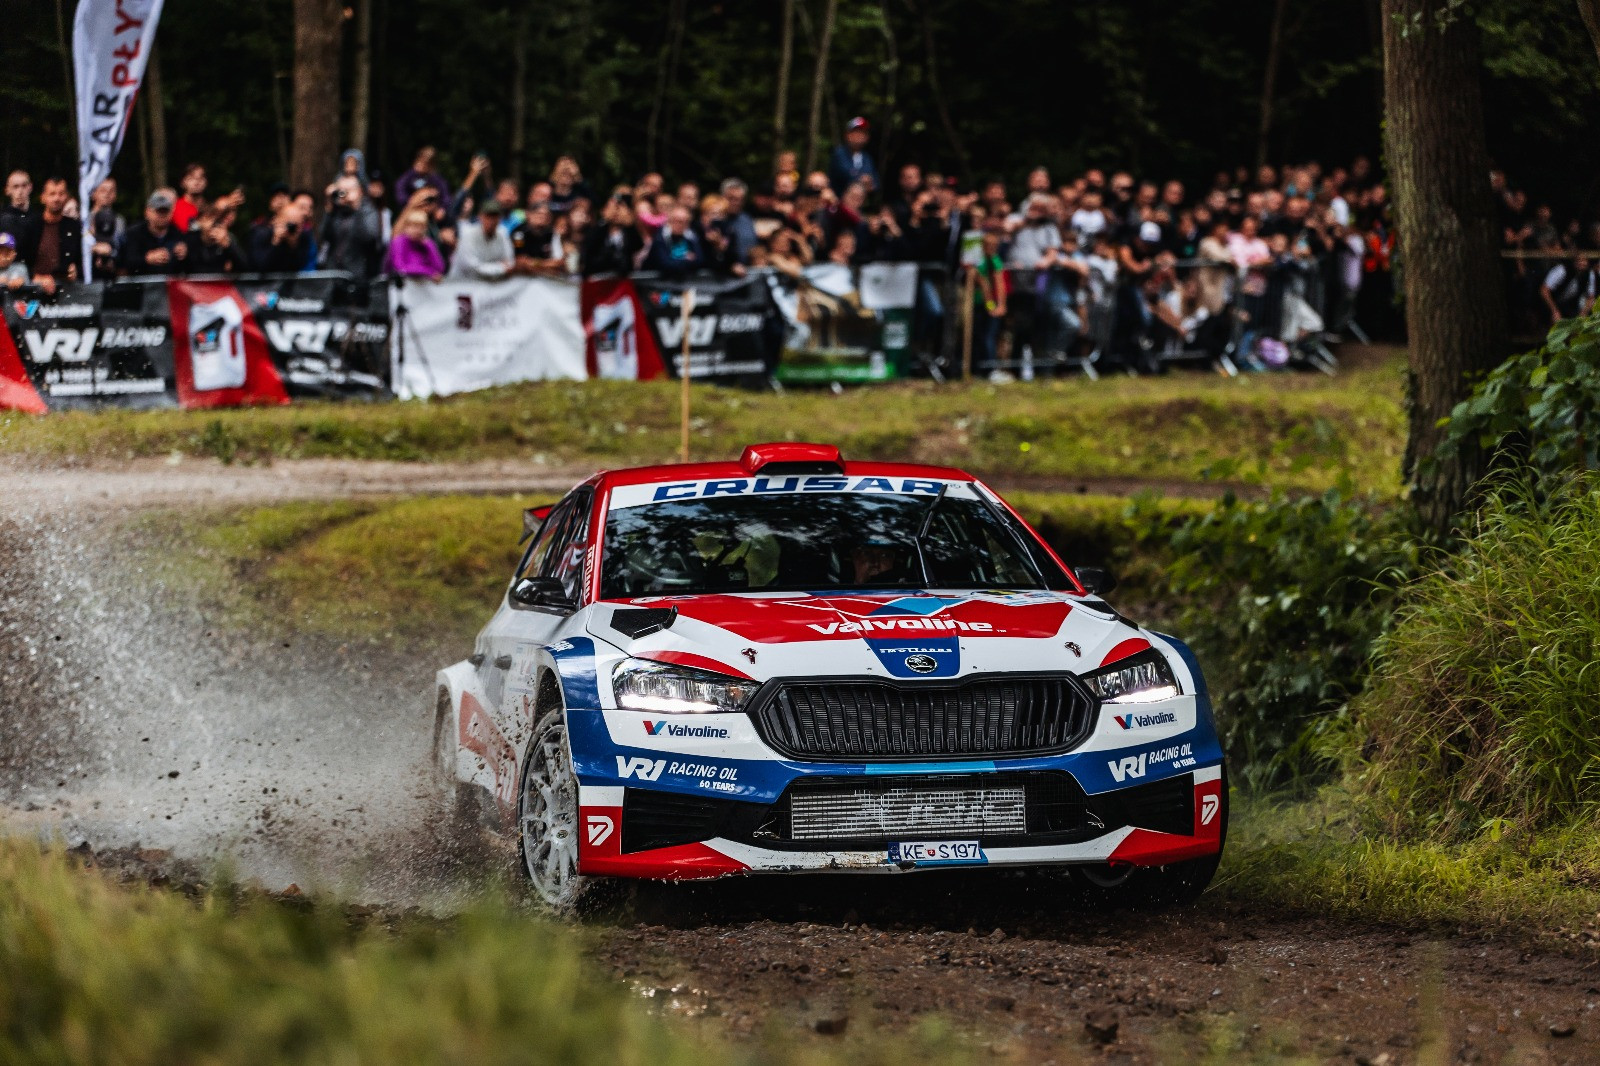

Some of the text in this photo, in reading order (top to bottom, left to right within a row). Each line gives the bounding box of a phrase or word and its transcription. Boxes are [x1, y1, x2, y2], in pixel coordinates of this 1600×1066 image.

[101, 326, 166, 348] RACING
[653, 477, 946, 501] CRUSAR
[806, 618, 993, 635] Valvoline
[1135, 712, 1175, 727] Valvoline
[668, 725, 728, 738] Valvoline
[615, 756, 738, 781] VR1 RACING OIL
[1107, 743, 1193, 782] VR1 RACING OIL
[1181, 757, 1196, 767] YEARS
[699, 780, 735, 791] 60 YEARS
[903, 843, 978, 859] KE S197
